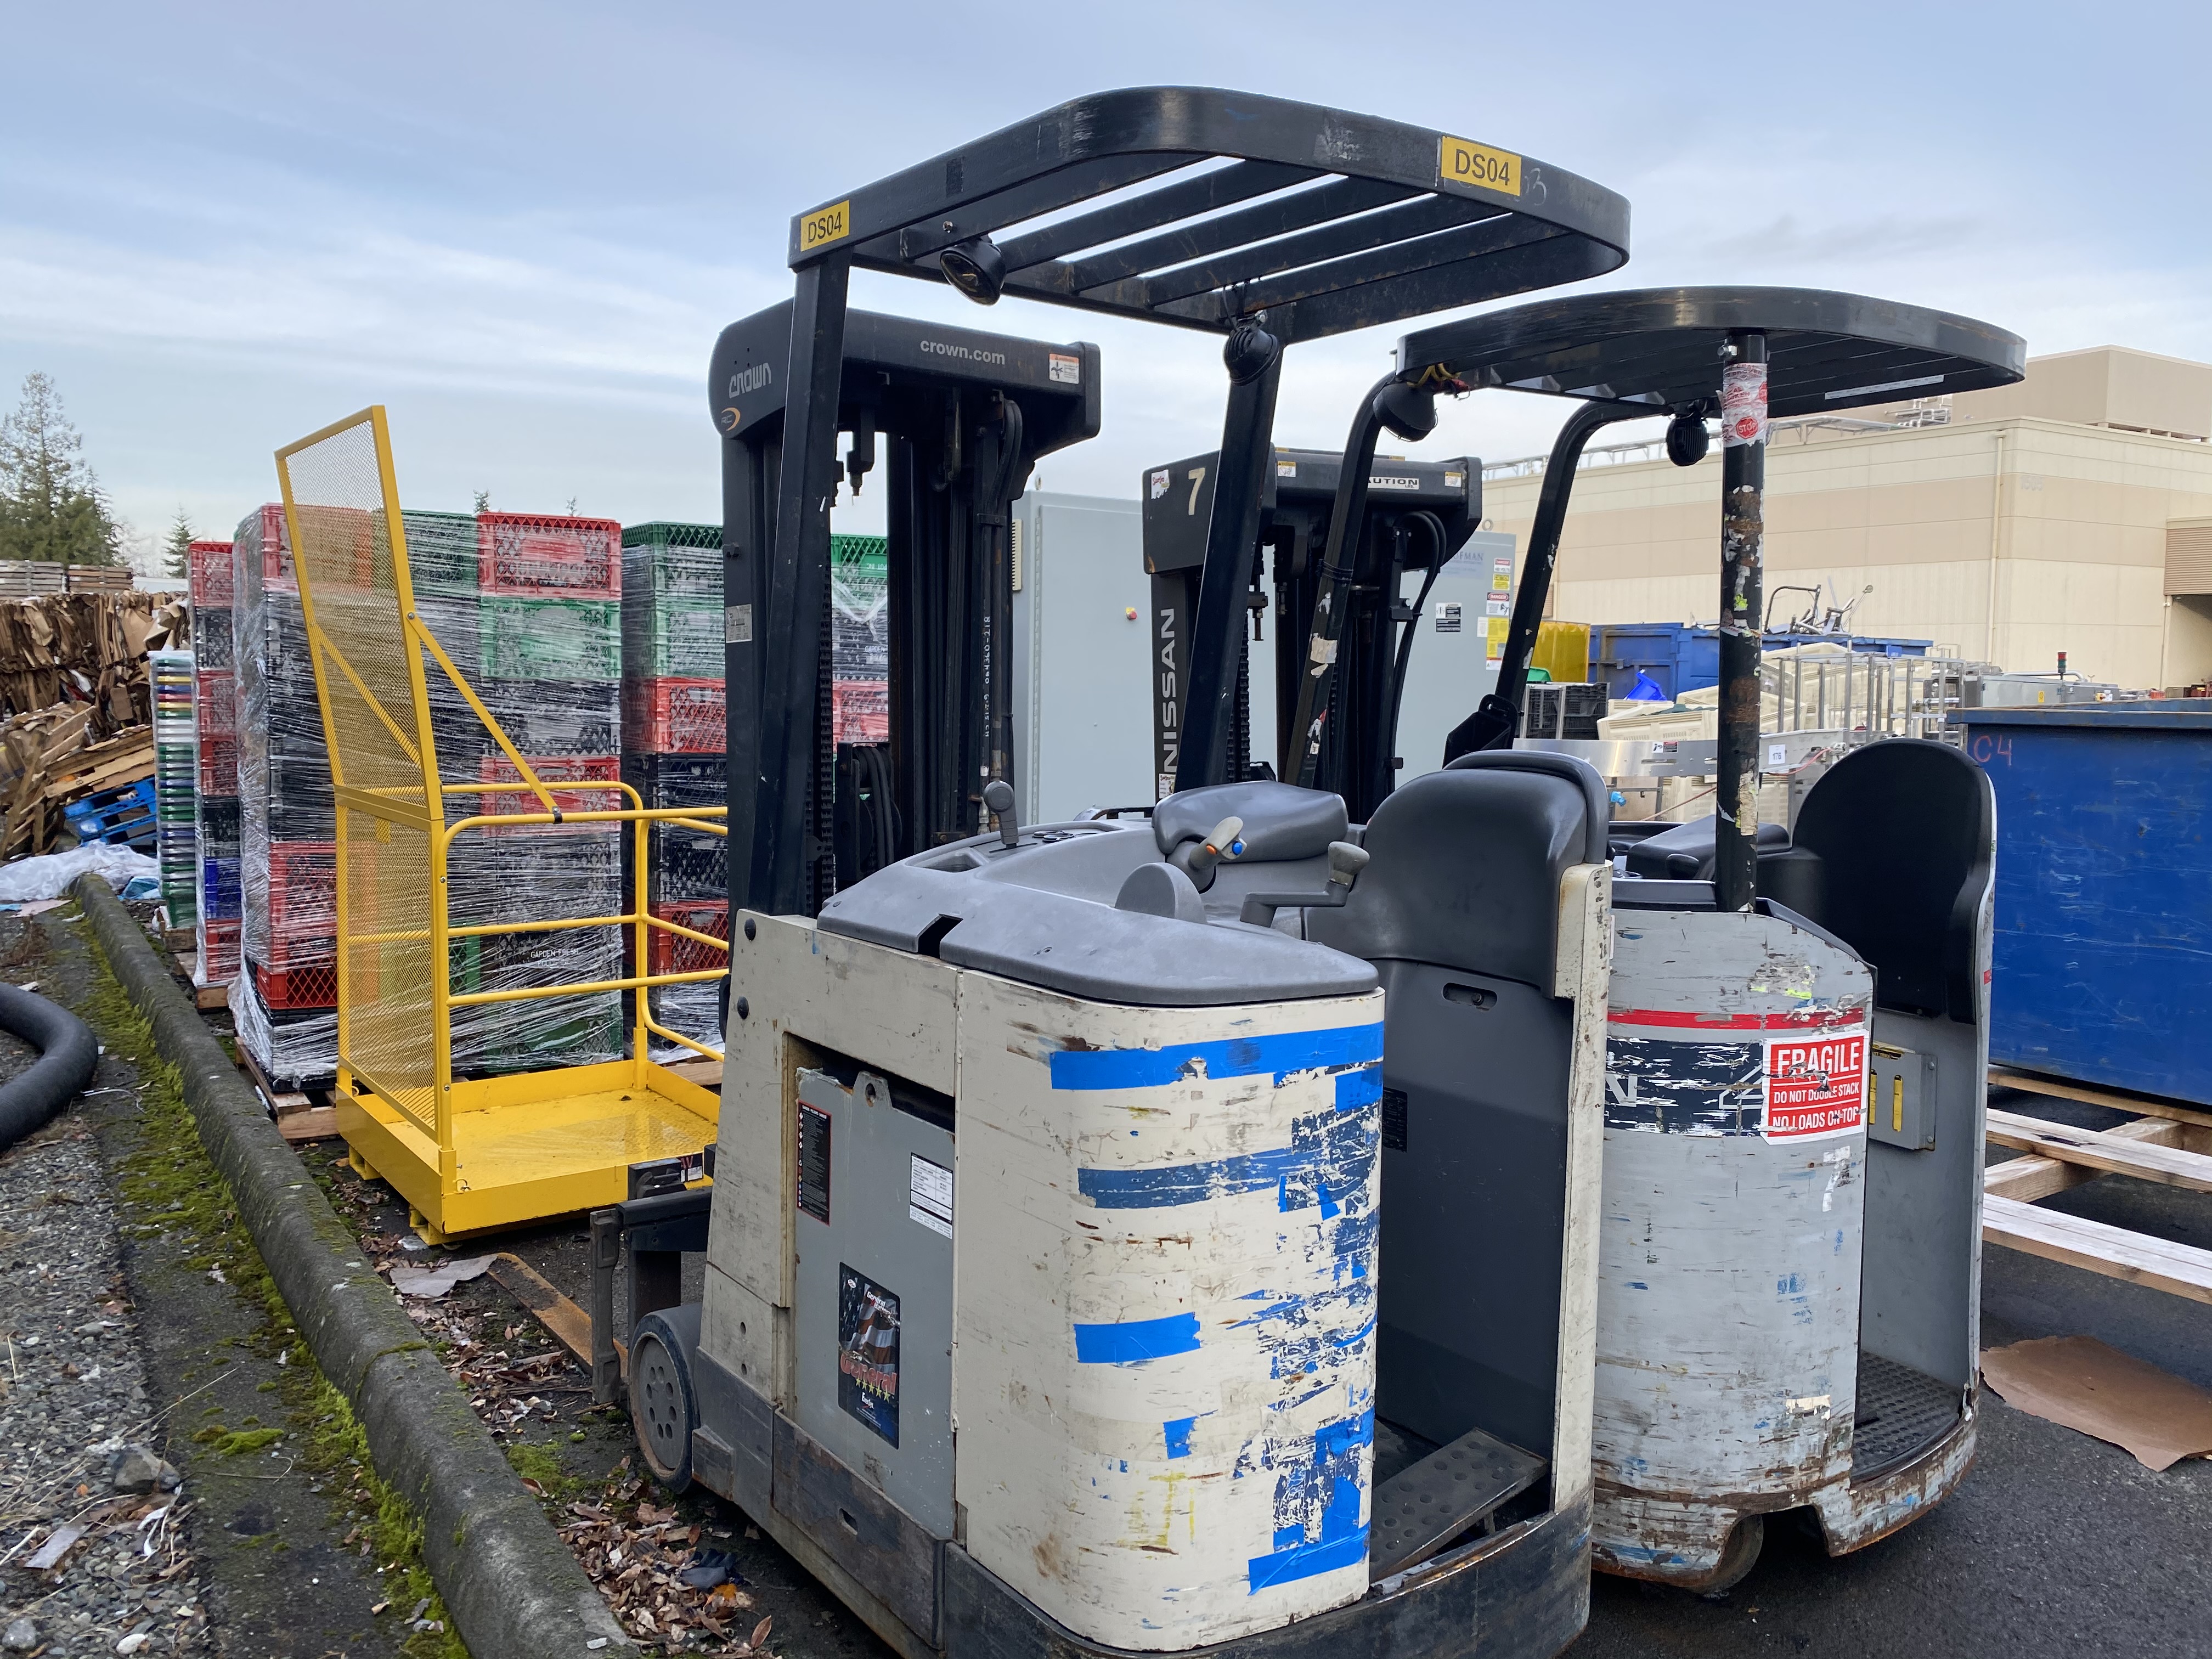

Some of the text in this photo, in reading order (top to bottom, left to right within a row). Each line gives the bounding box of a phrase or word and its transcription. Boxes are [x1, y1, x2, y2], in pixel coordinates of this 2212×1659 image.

[1455, 149, 1510, 185] DS04
[808, 211, 842, 243] DS04
[920, 340, 1005, 365] crown.com
[1738, 421, 1756, 433] STOP
[1188, 467, 1205, 516] 7
[1160, 608, 1177, 772] NISSAN
[1777, 1041, 1860, 1076] FRAGILE
[1774, 1091, 1787, 1104] DO
[1789, 1090, 1807, 1103] NOT
[1838, 1082, 1859, 1097] STACK
[1773, 1115, 1789, 1127] NO
[1792, 1111, 1825, 1130] LOADS
[1842, 1107, 1859, 1123] TOP
[840, 1353, 897, 1395] General
